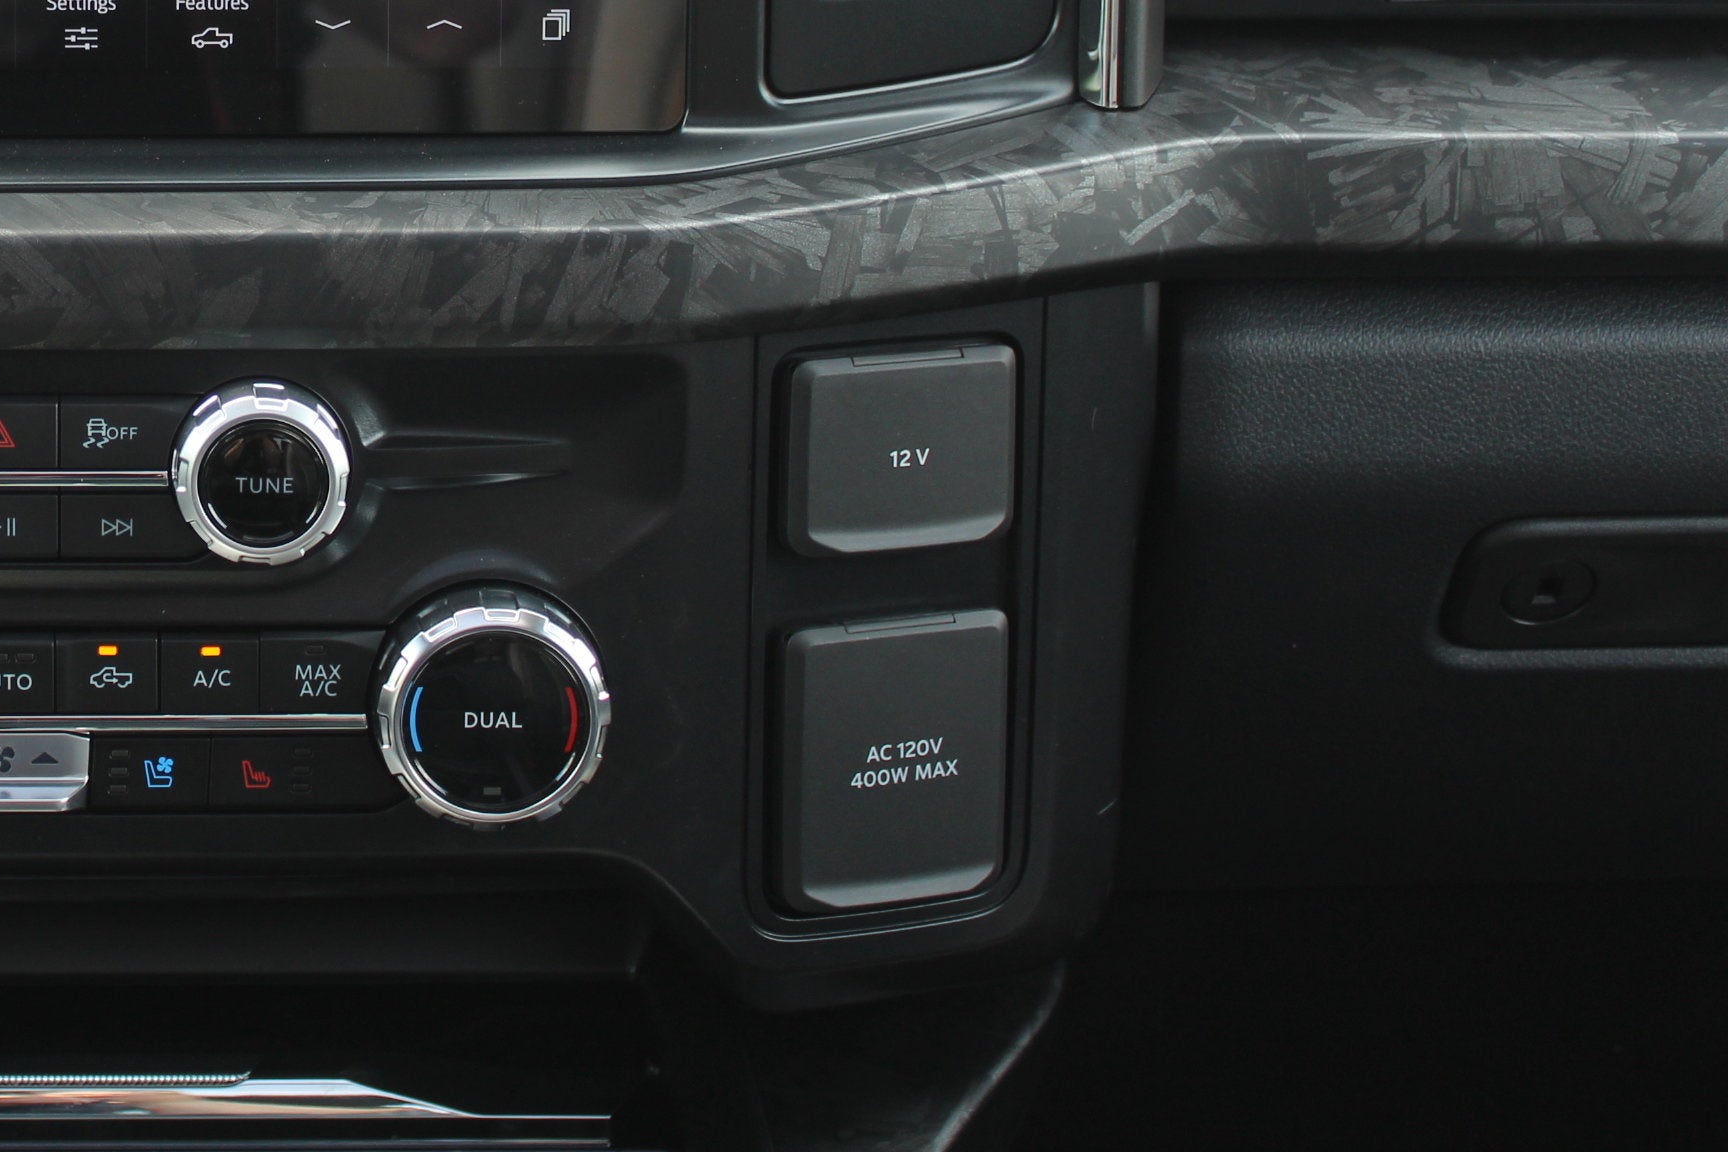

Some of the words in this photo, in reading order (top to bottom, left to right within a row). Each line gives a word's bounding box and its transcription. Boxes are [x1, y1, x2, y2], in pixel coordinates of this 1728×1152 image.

[107, 426, 138, 440] OFF
[889, 449, 911, 468] 12
[915, 447, 930, 466] V
[235, 476, 294, 494] TUNE
[193, 668, 231, 689] A/C
[295, 664, 342, 681] MAX
[299, 680, 337, 697] A/C
[464, 711, 523, 729] DUAL
[866, 744, 893, 764] AC
[896, 736, 943, 759] 120V
[850, 766, 909, 789] 400W
[915, 758, 958, 781] MAX
